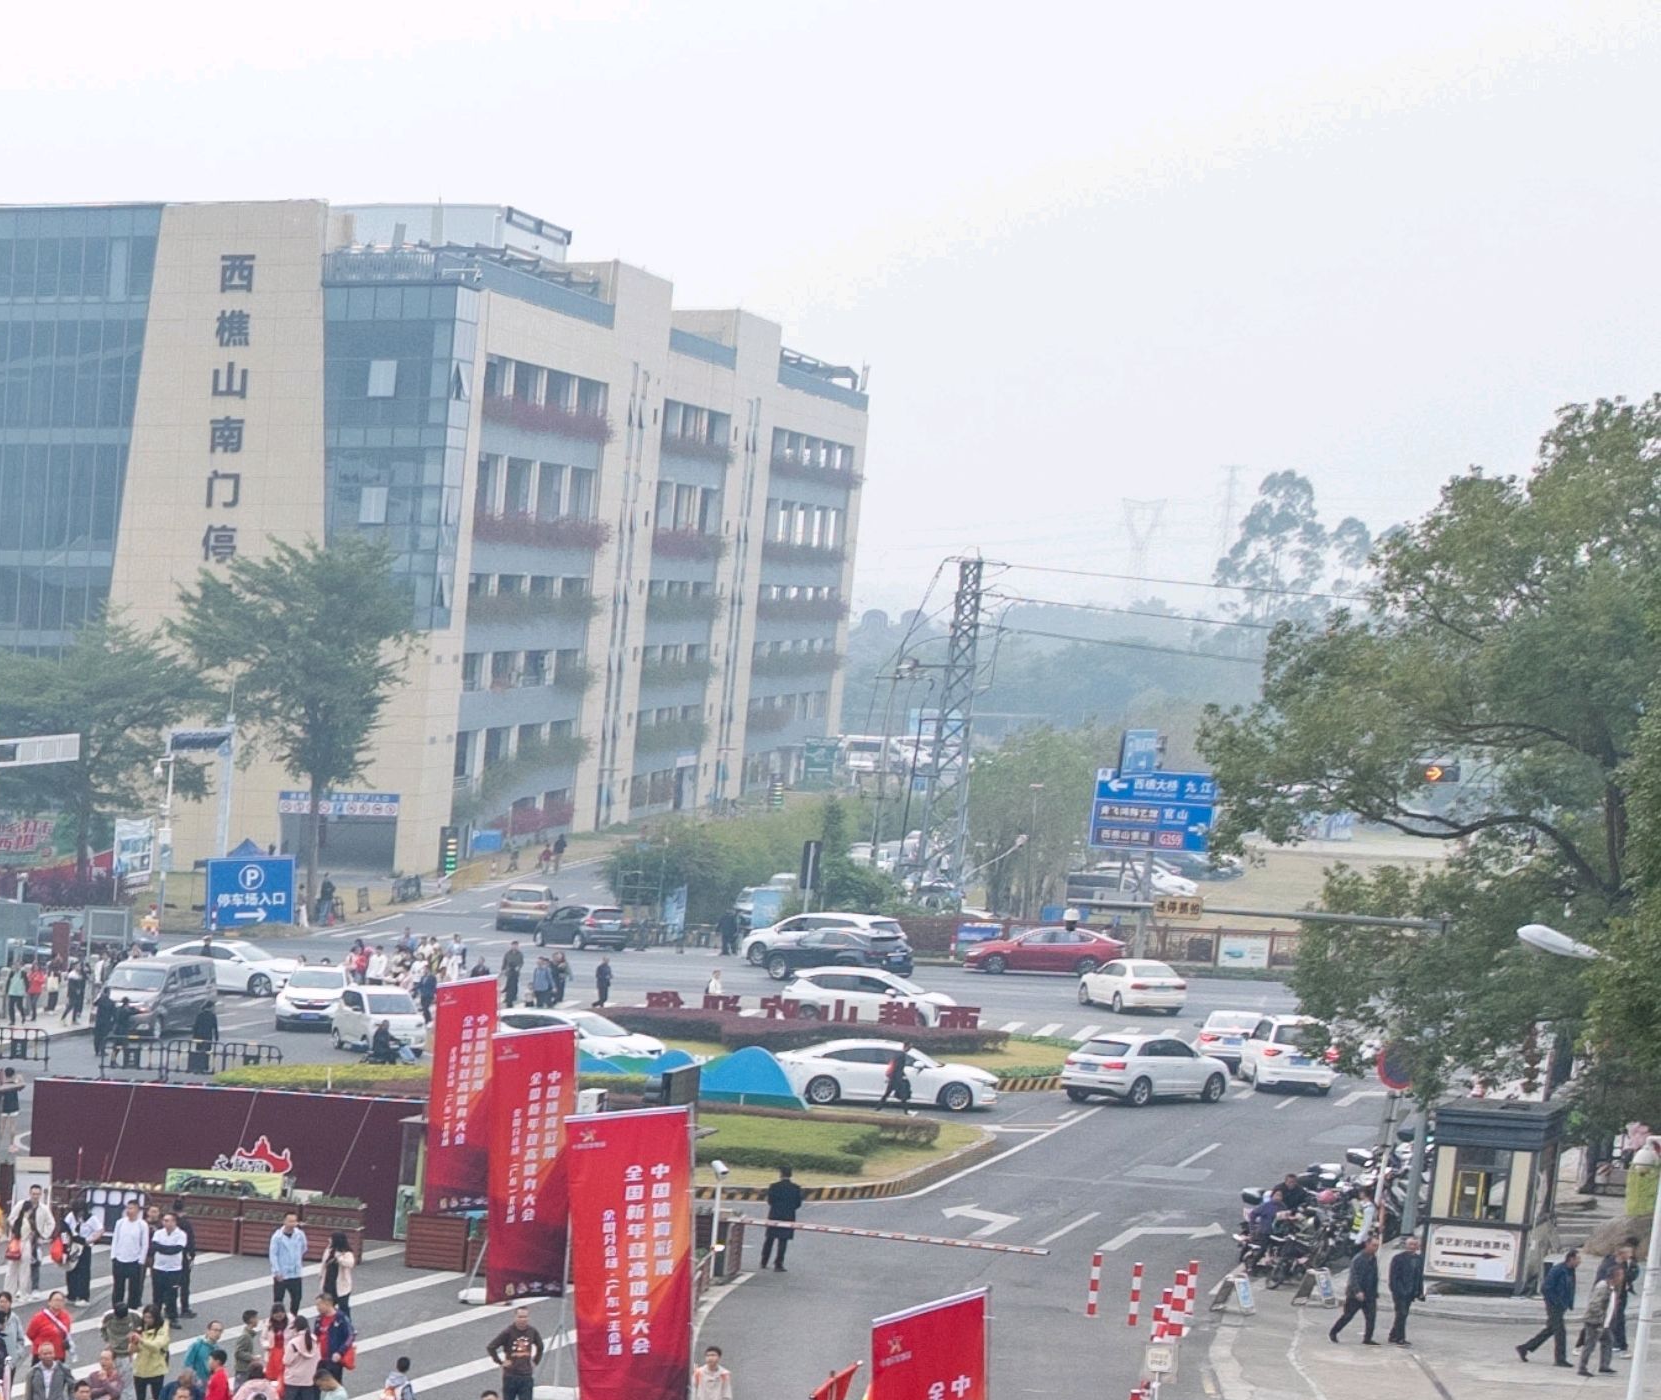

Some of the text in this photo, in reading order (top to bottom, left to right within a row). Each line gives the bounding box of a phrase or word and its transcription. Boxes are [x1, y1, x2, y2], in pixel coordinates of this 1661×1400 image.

[202, 254, 256, 563] 西樵山南门停
[217, 892, 286, 908] 停车场入口
[246, 871, 260, 887] P
[623, 1164, 651, 1355] 全国新年登高健身大会
[650, 1163, 675, 1276] 中国体育彩票
